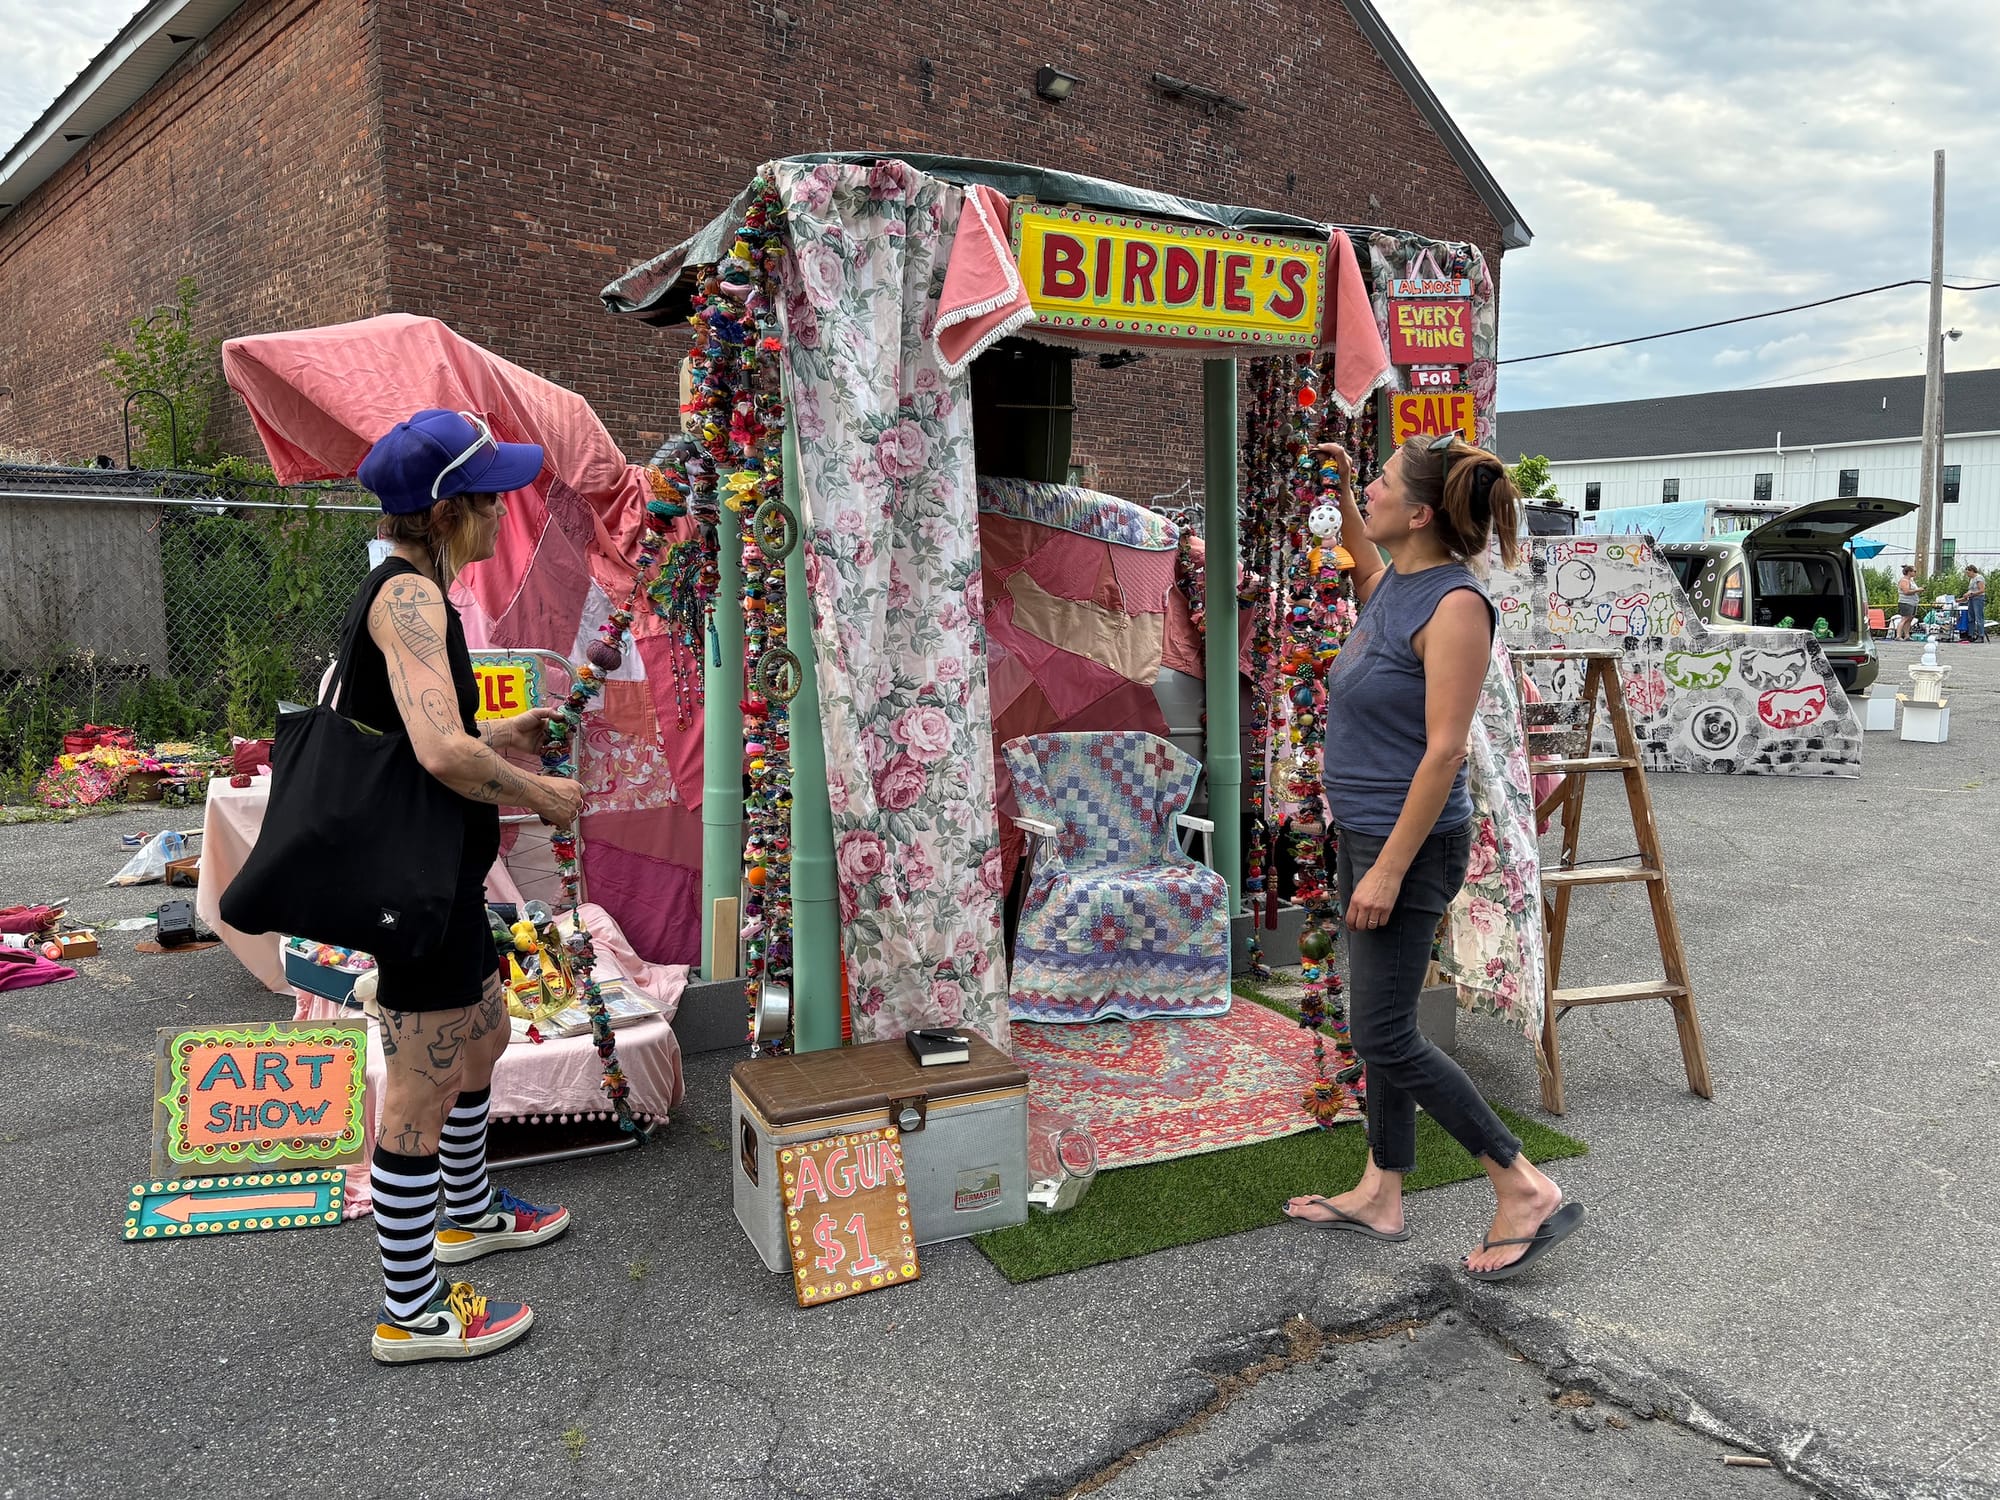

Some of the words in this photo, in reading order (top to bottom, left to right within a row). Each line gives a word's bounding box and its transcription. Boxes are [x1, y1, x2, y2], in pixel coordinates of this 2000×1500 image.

[1041, 233, 1308, 318] BIRDIE'S
[1399, 280, 1461, 294] ALMOST
[1398, 305, 1464, 327] EVERY
[1400, 326, 1465, 347] THING
[1418, 371, 1452, 386] FOR
[1400, 397, 1466, 438] SALE
[475, 672, 518, 711] LE
[197, 1053, 334, 1091] ART
[205, 1099, 331, 1133] SHOW
[795, 1140, 903, 1209] AGUA
[812, 1212, 880, 1275] $1
